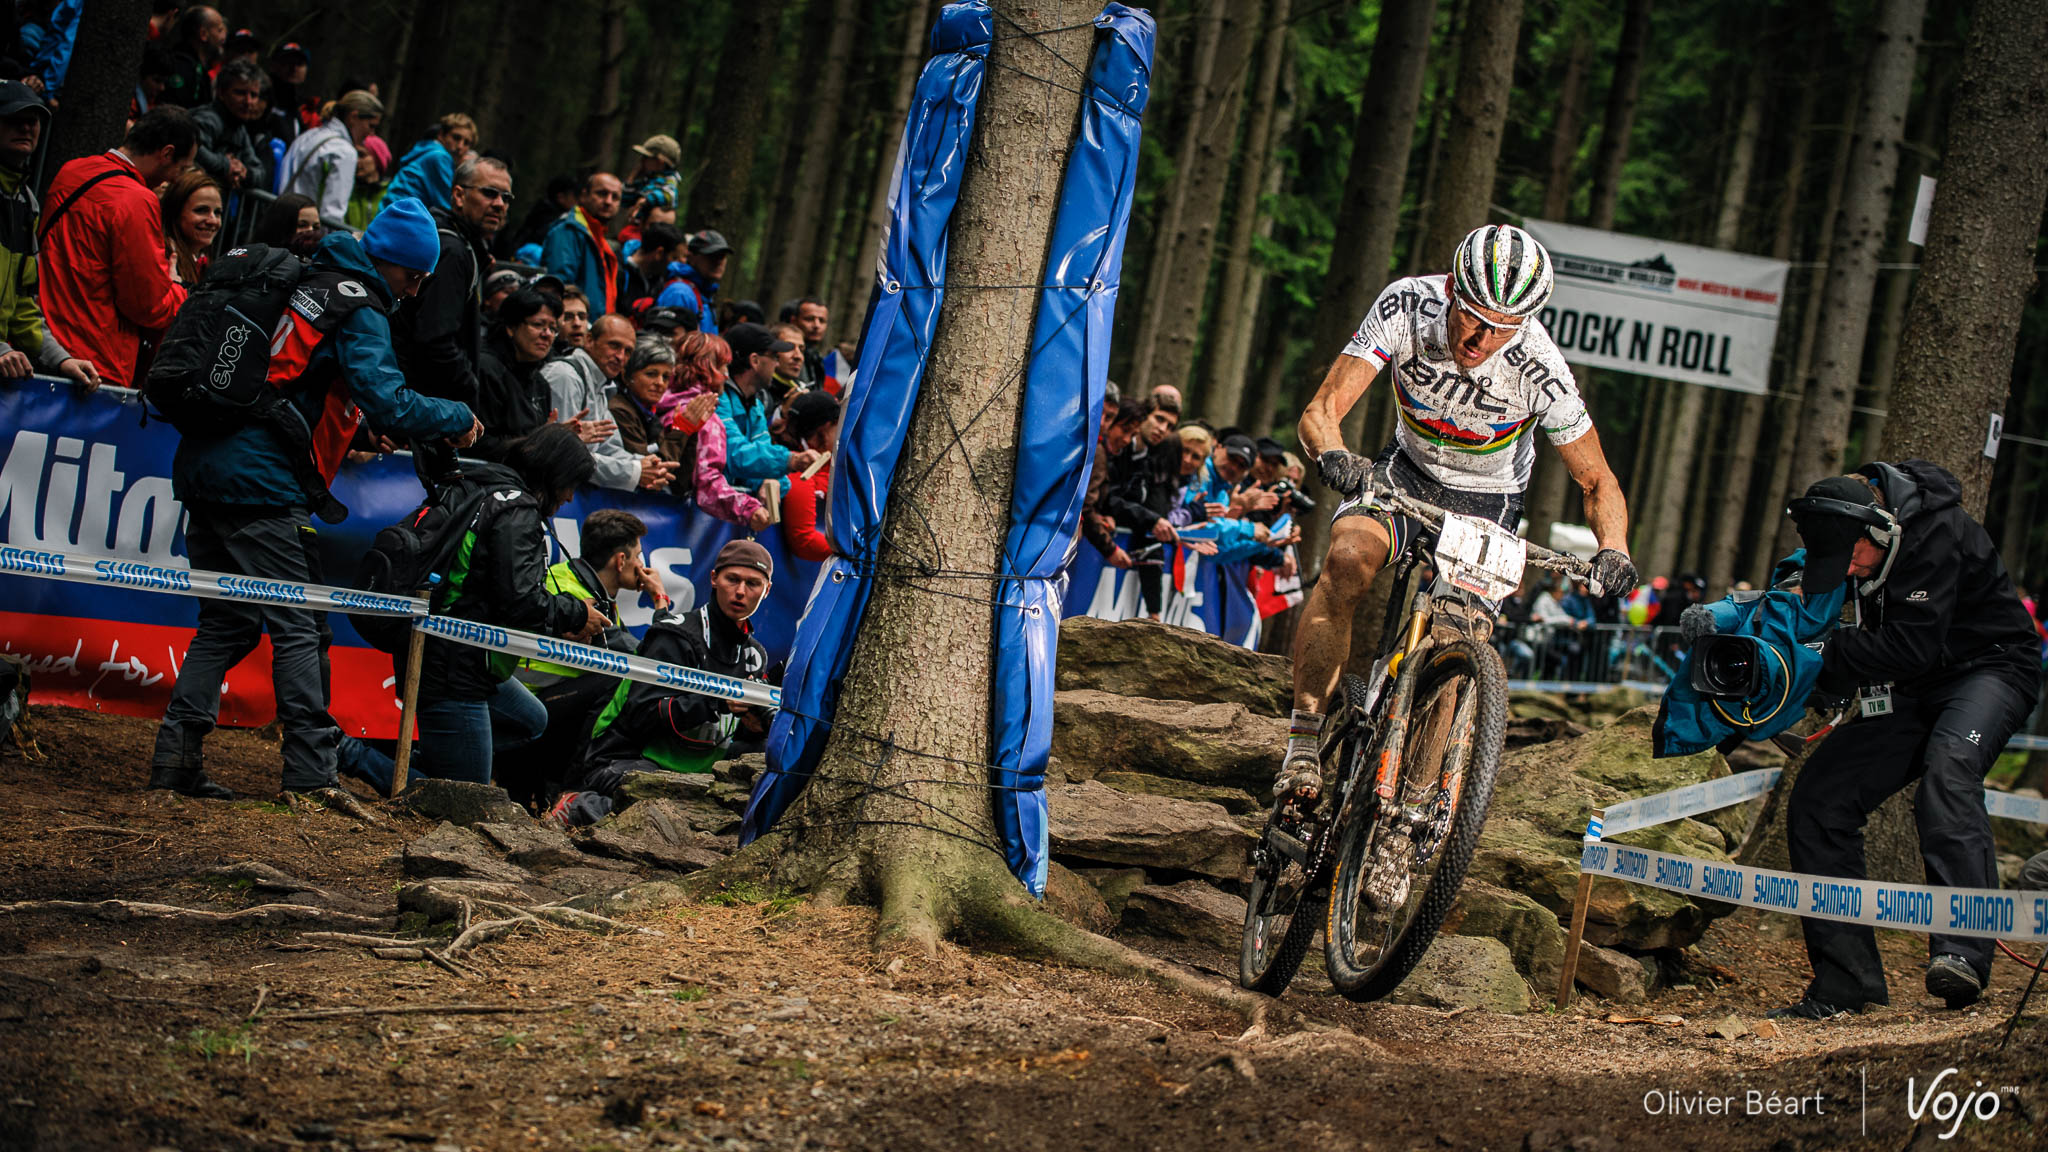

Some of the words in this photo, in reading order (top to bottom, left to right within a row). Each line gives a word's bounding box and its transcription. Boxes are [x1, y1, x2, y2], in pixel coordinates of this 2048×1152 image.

[306, 302, 323, 316] CUP
[1540, 306, 1625, 357] ROCK
[1628, 321, 1654, 363] N
[1658, 325, 1732, 377] ROLL
[1399, 353, 1508, 414] BMC
[1503, 342, 1568, 403] BMC
[0, 547, 66, 576] MANO
[95, 560, 191, 591] SHIMANO
[217, 576, 307, 605] SHIMANO
[1477, 534, 1491, 566] 1
[88, 639, 164, 699] for
[412, 615, 508, 648] HIMANO
[536, 638, 630, 675] SHIMANO
[656, 664, 745, 699] SHIMANO
[1613, 849, 1648, 880] SHIMANO
[1655, 857, 1693, 890] SHIMANO
[1701, 866, 1743, 900] SHIMANO
[1753, 874, 1799, 909] SHIMANO
[1811, 882, 1862, 918] SHIMANO
[1876, 889, 1933, 926] SHIMANO
[1949, 894, 2014, 933] SHIMANO
